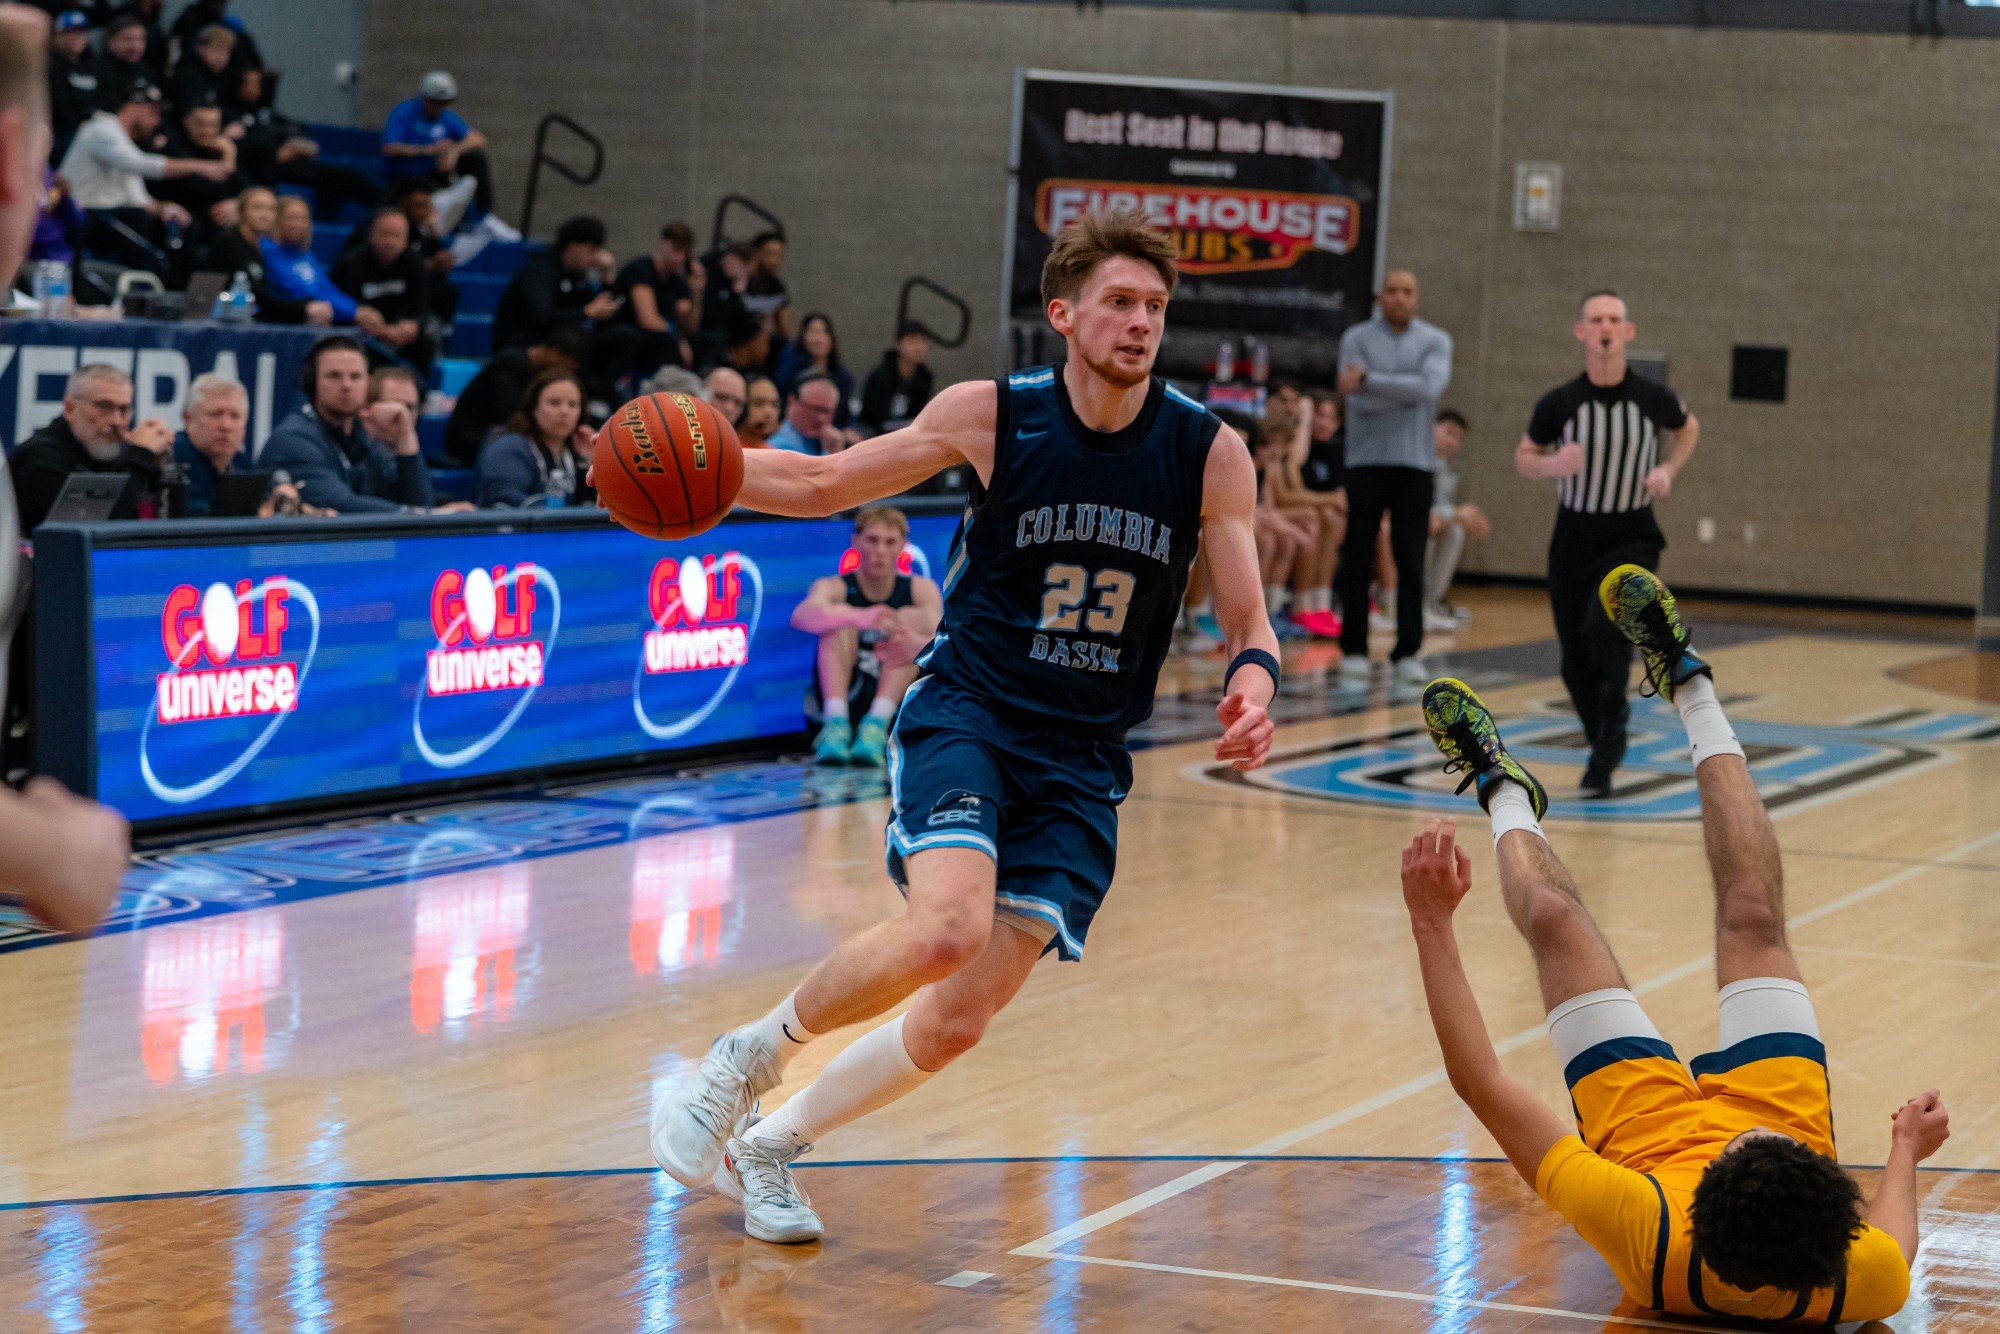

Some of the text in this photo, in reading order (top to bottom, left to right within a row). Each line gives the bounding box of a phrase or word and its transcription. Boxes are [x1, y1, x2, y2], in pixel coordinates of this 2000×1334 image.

[1064, 108, 1124, 146] Best
[1126, 112, 1185, 150] Seat
[1049, 188, 1348, 256] FIREHOUSE
[1172, 231, 1253, 263] UBS
[619, 401, 666, 476] Baden
[1016, 504, 1171, 564] COLUMBIA
[430, 562, 537, 646] GOLF
[648, 551, 741, 629] GOLF
[1035, 562, 1136, 637] 23
[162, 574, 290, 669] GOLF
[645, 625, 747, 673] universe
[158, 665, 297, 722] universe
[428, 644, 542, 694] universe
[927, 809, 981, 826] CBC
